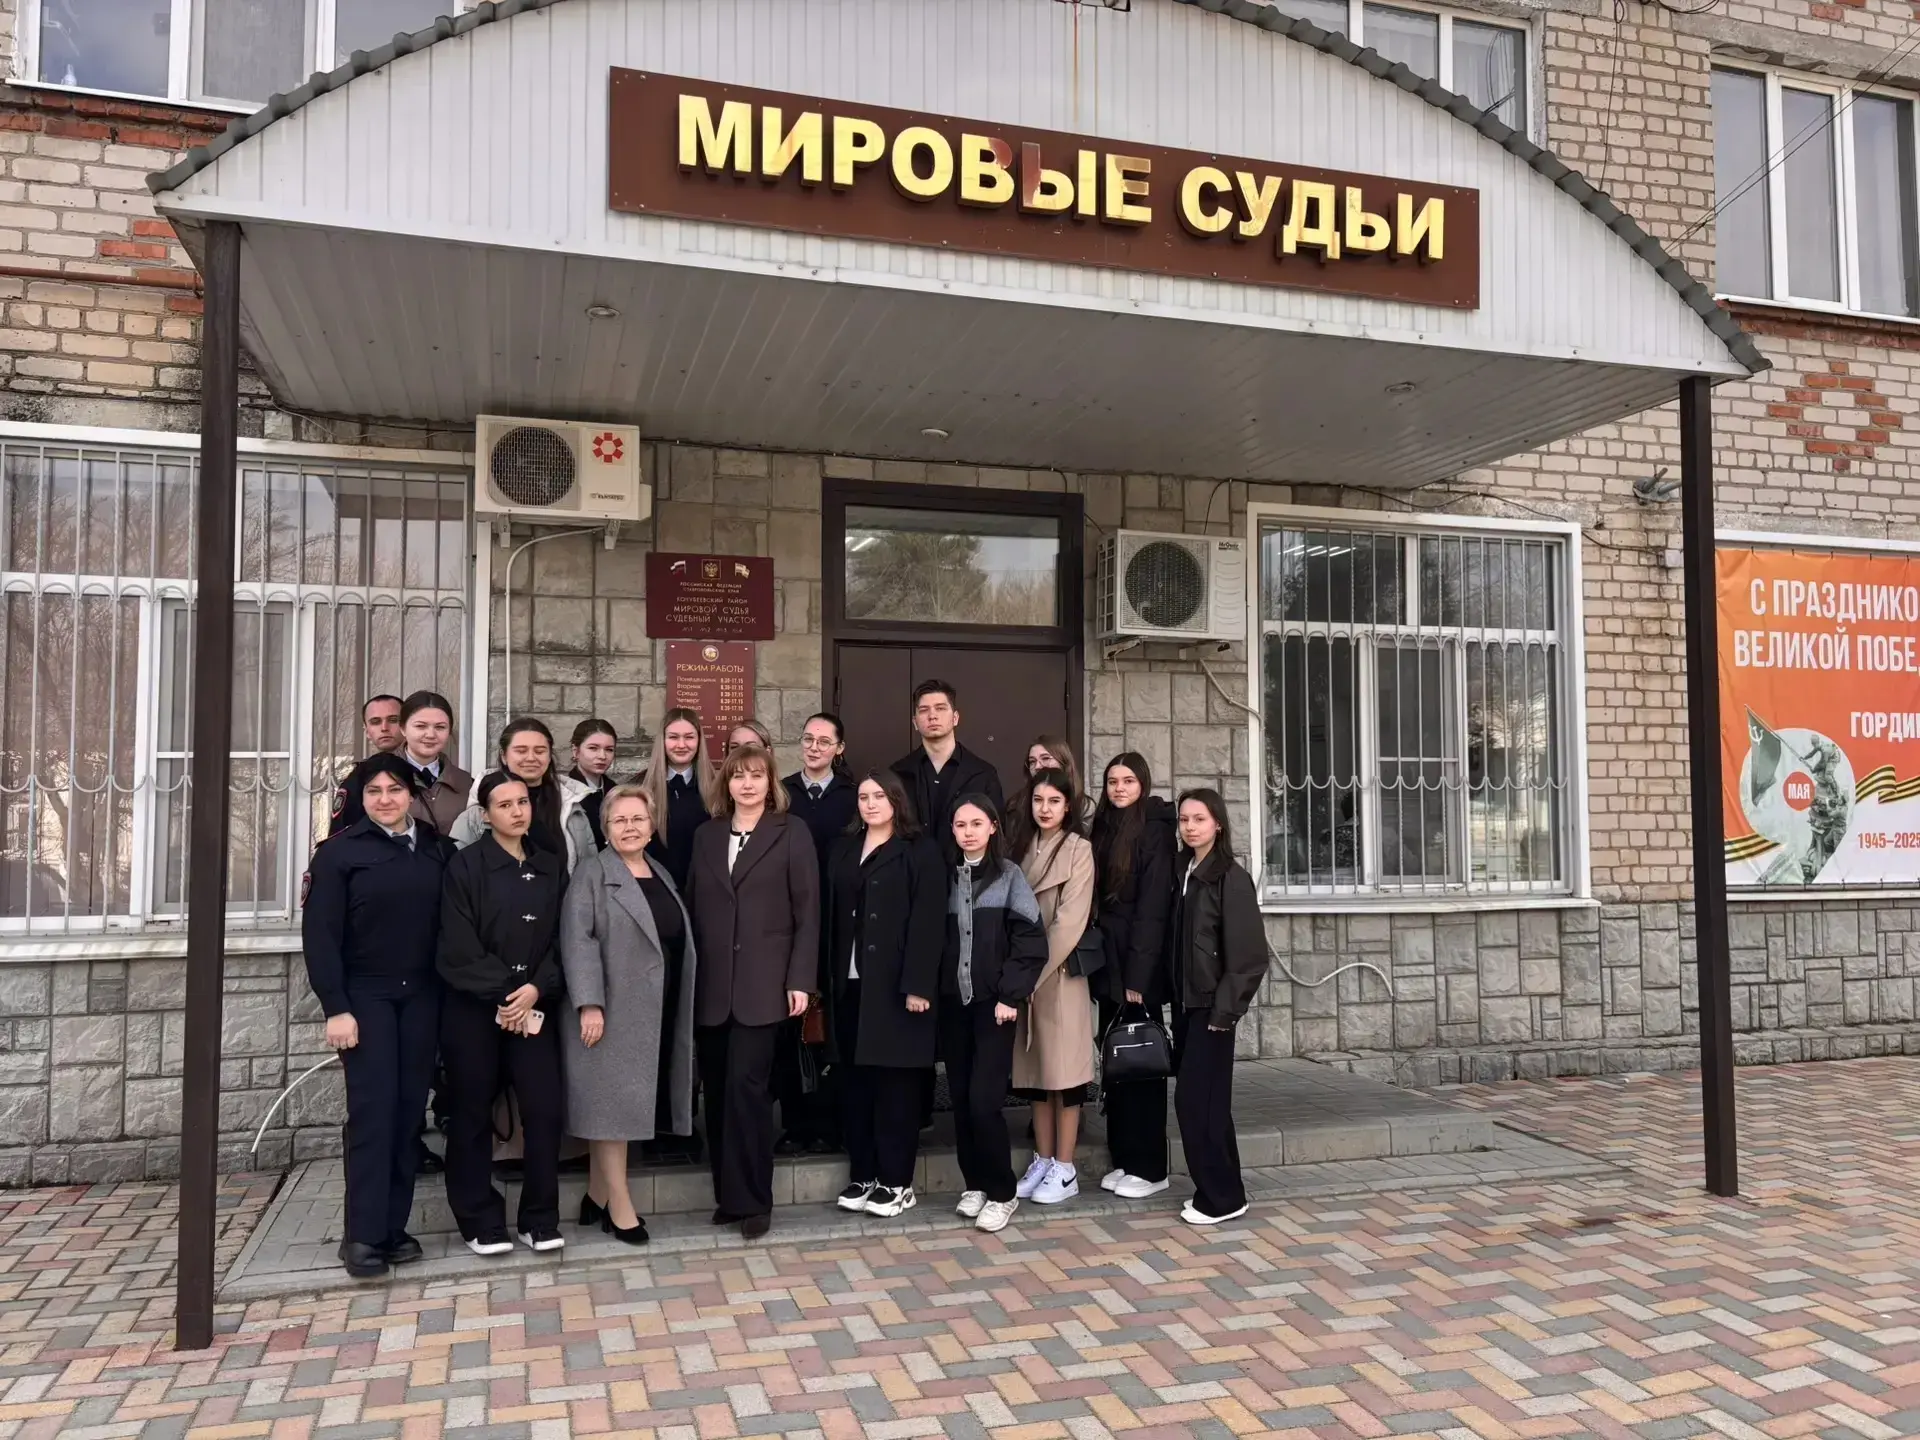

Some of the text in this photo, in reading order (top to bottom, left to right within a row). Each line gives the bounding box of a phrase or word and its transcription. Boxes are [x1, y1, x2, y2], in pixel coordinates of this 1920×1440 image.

[677, 94, 1444, 261] МИРОВЫЕ СУДЬИ
[1750, 578, 1919, 624] С ПРАЗДНИКО
[673, 604, 749, 615] МИРОВОЙ СУДЬЯ
[665, 613, 757, 624] СУДЕБНЫЙ УЧАСТОК
[1734, 626, 1920, 676] ВЕЛИКОЙ ПОБЕ
[676, 663, 745, 673] РЕЖИМ РАБОТЫ
[676, 690, 698, 698] Среда
[1788, 782, 1811, 800] МАЯ
